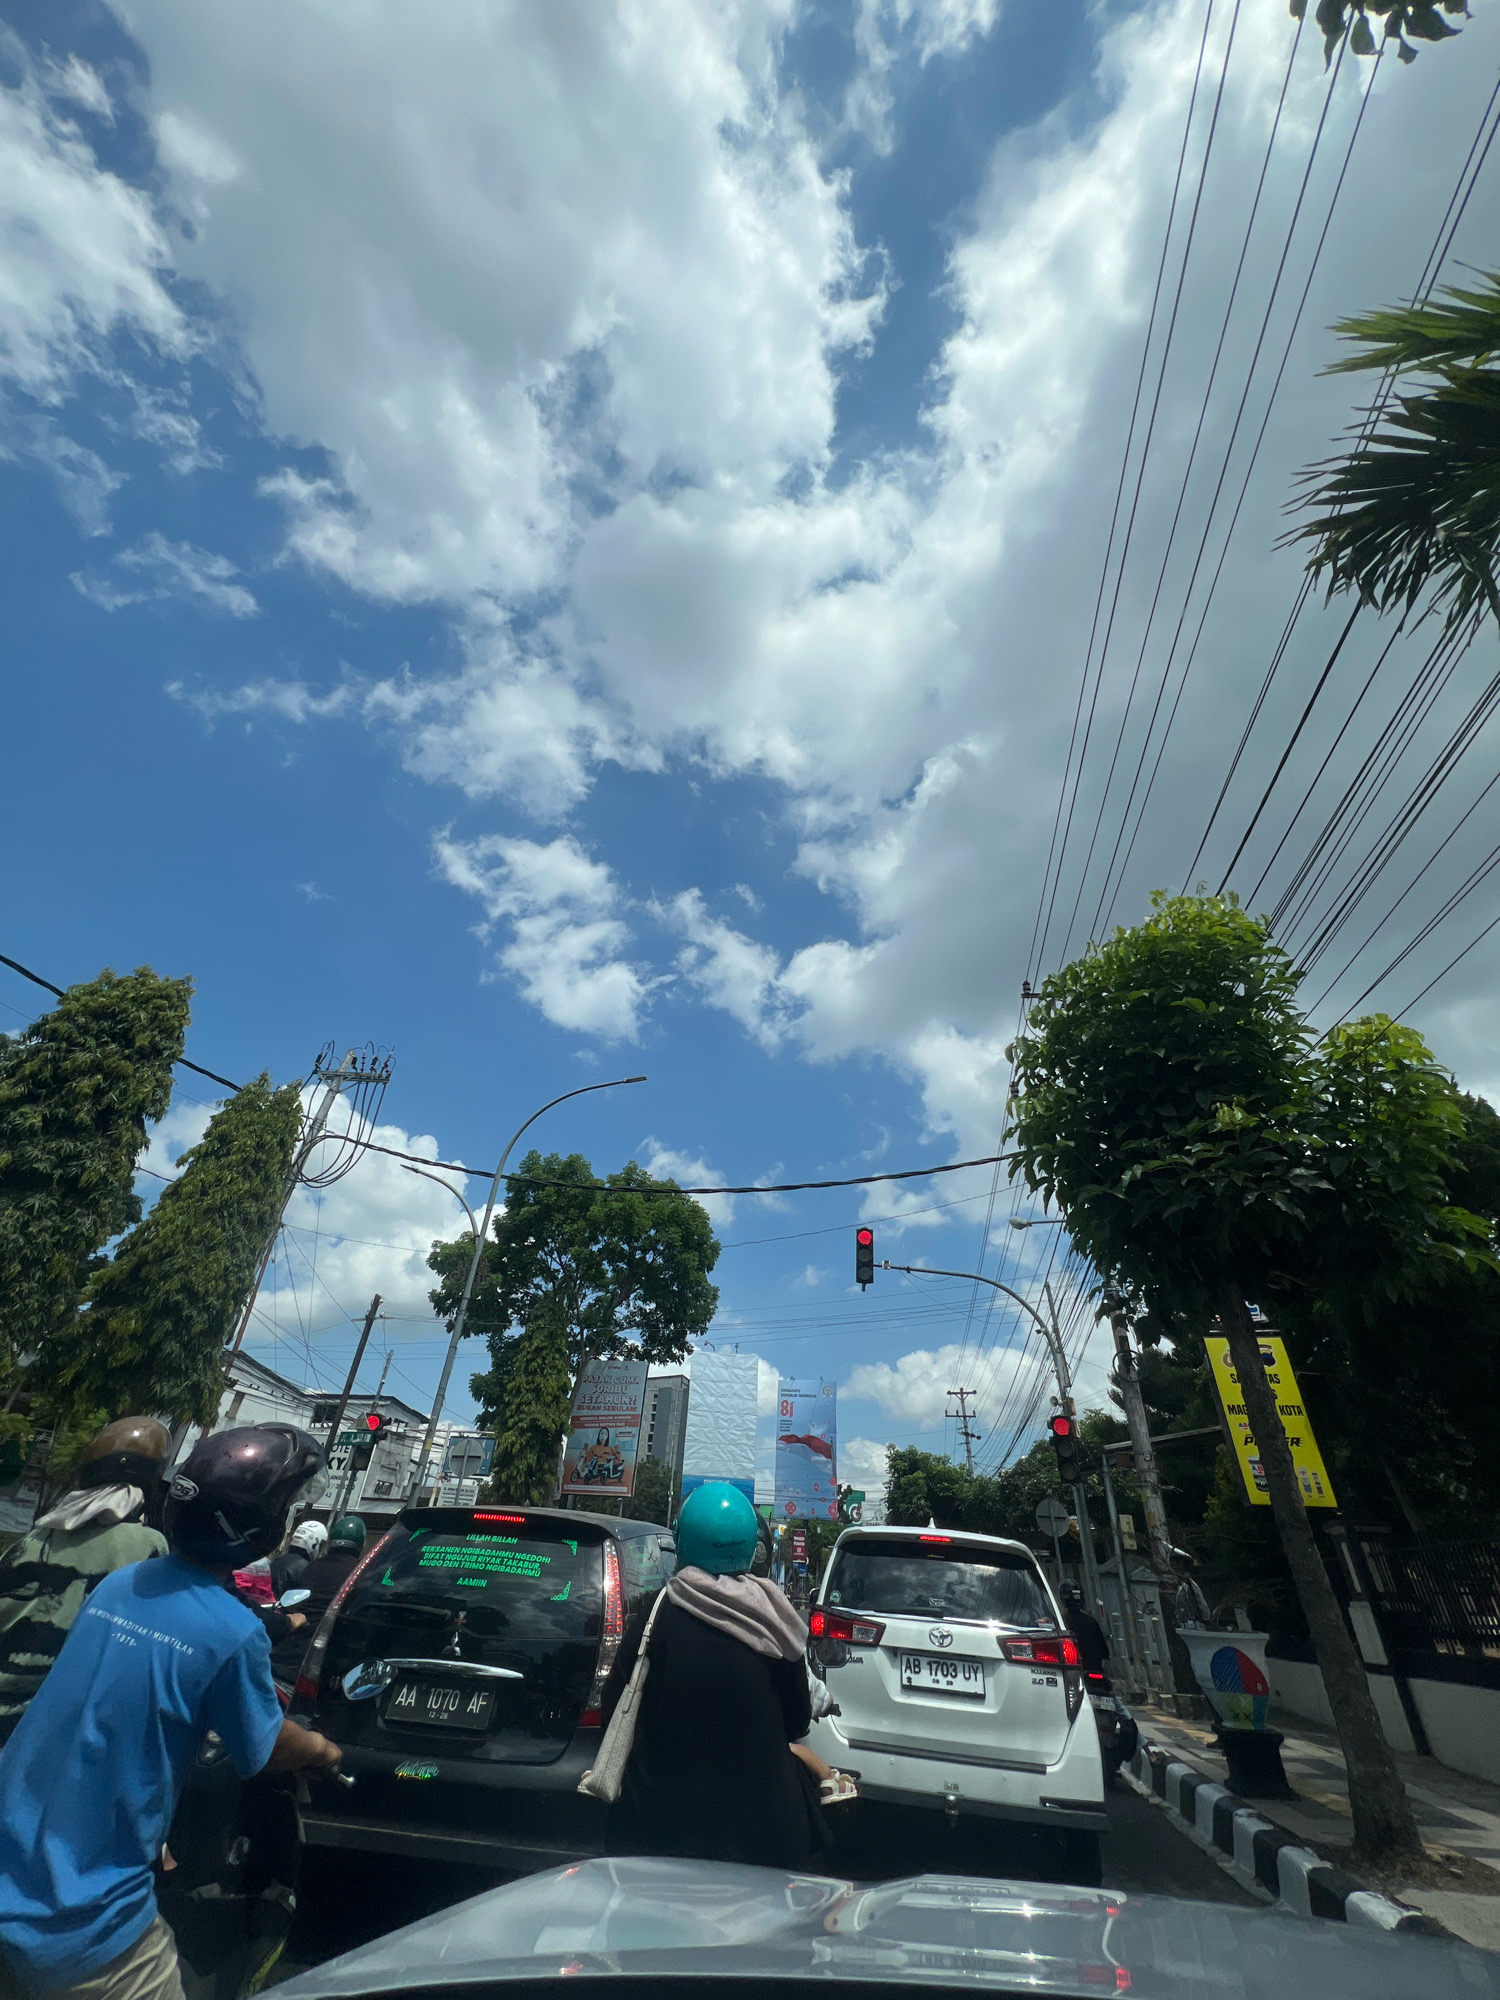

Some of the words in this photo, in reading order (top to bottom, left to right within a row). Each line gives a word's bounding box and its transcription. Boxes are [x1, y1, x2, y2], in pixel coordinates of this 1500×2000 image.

[613, 1375, 640, 1385] CUMA
[591, 1384, 630, 1395] 50RIBU
[781, 1400, 794, 1419] 81
[1278, 1405, 1304, 1416] KOTA
[466, 1534, 491, 1542] LILLAH
[491, 1535, 518, 1544] BILLAH
[445, 1554, 478, 1562] NGUJUB
[477, 1556, 503, 1565] RIYAK
[460, 1547, 515, 1559] NGIBADAHMU
[514, 1553, 551, 1564] NGEDOHI
[460, 1562, 485, 1570] TRIMO
[485, 1564, 541, 1578] NGIBADAHMU
[456, 1577, 488, 1587] AAMIIN
[153, 1631, 194, 1655] MUNTILAN
[904, 1657, 921, 1675] AB
[927, 1660, 958, 1679] 1703
[962, 1664, 980, 1682] UY
[395, 1684, 417, 1707] AA
[427, 1688, 460, 1711] 1070
[466, 1691, 490, 1714] AF
